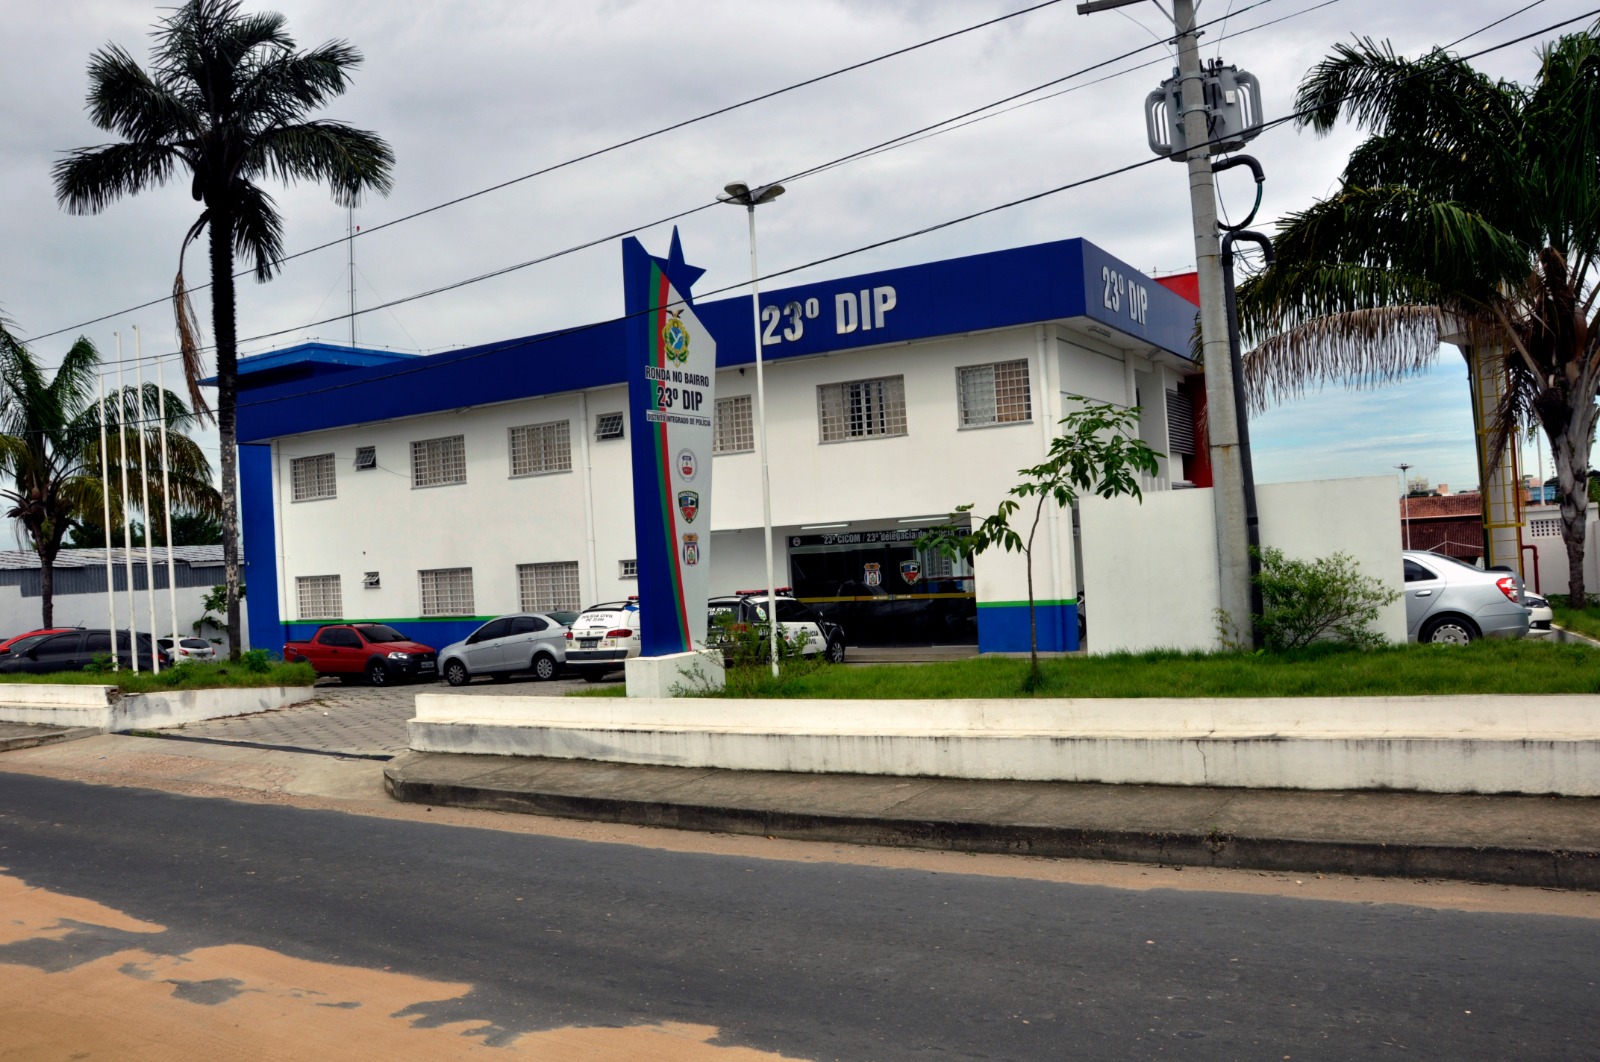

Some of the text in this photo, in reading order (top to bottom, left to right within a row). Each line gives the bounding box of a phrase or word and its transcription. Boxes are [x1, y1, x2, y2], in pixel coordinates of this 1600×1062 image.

[834, 285, 897, 335] DIP
[1128, 279, 1148, 325] DIP
[645, 366, 709, 388] RONDA NO BAIRRO
[682, 389, 703, 411] DIP
[837, 534, 861, 544] CICOM
